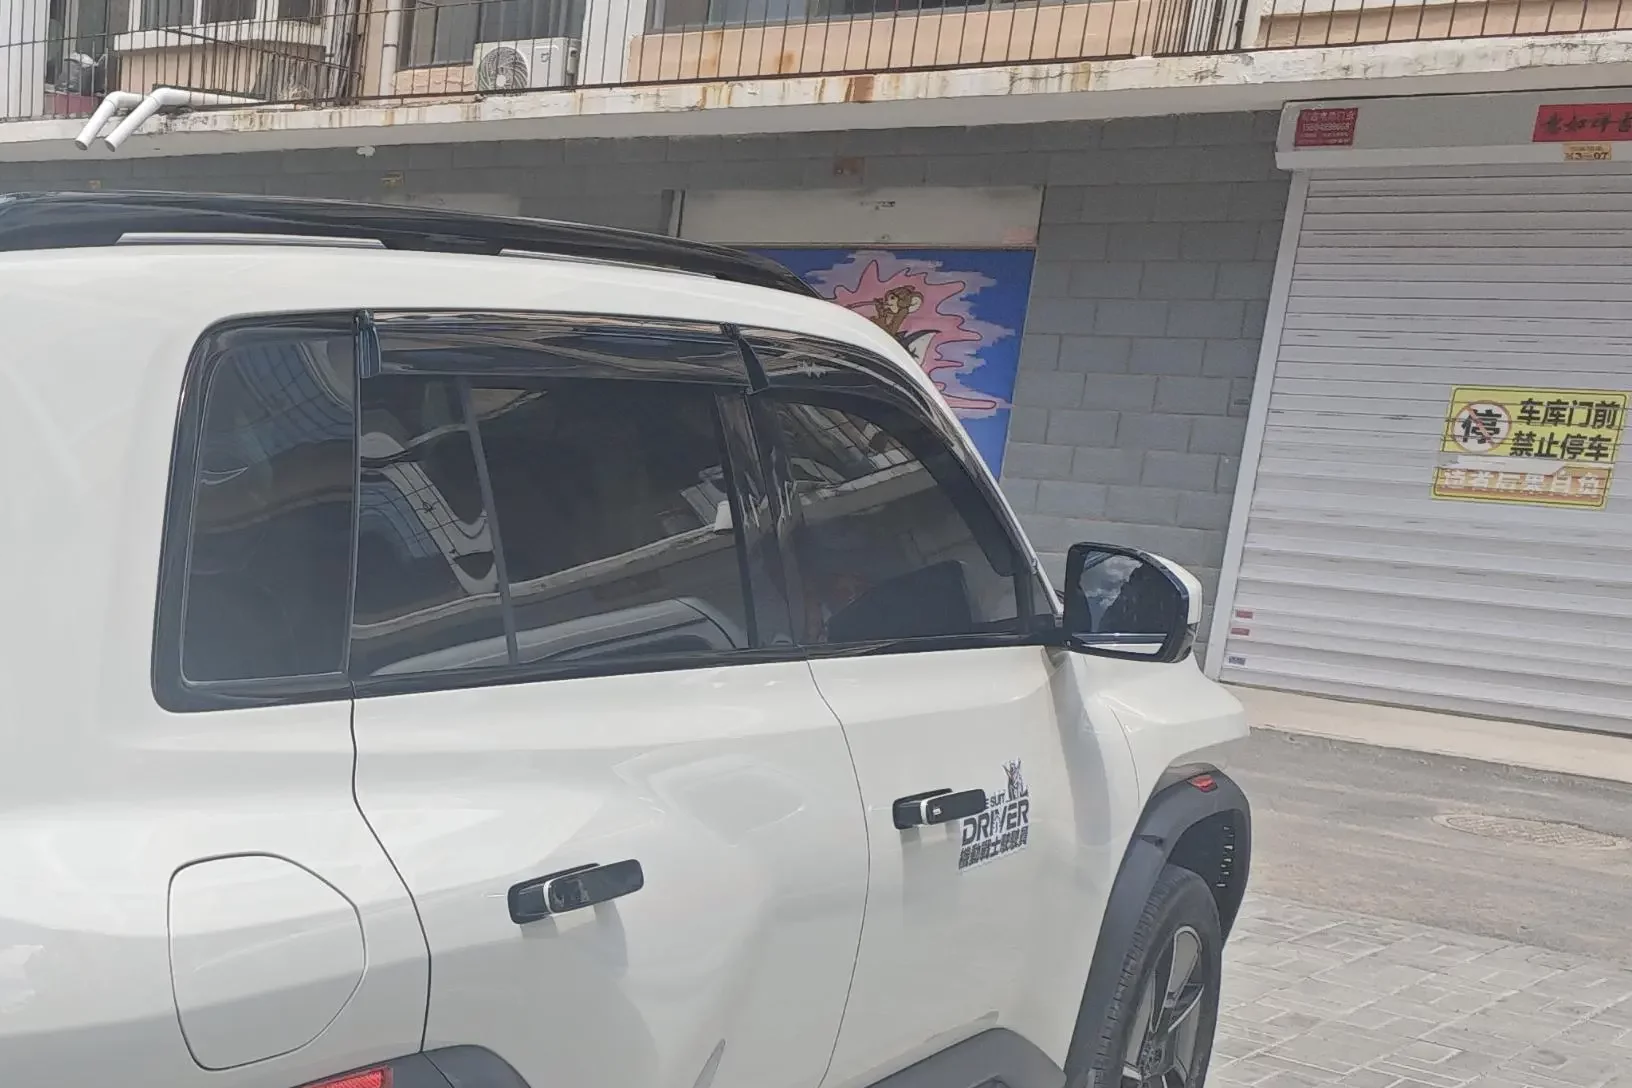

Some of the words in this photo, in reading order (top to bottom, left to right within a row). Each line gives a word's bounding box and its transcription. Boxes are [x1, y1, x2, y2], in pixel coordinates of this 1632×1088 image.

[1461, 409, 1502, 444] 停
[1517, 398, 1620, 430] 车库门前
[1509, 430, 1612, 461] 禁止停车
[962, 798, 1029, 848] DRIVER
